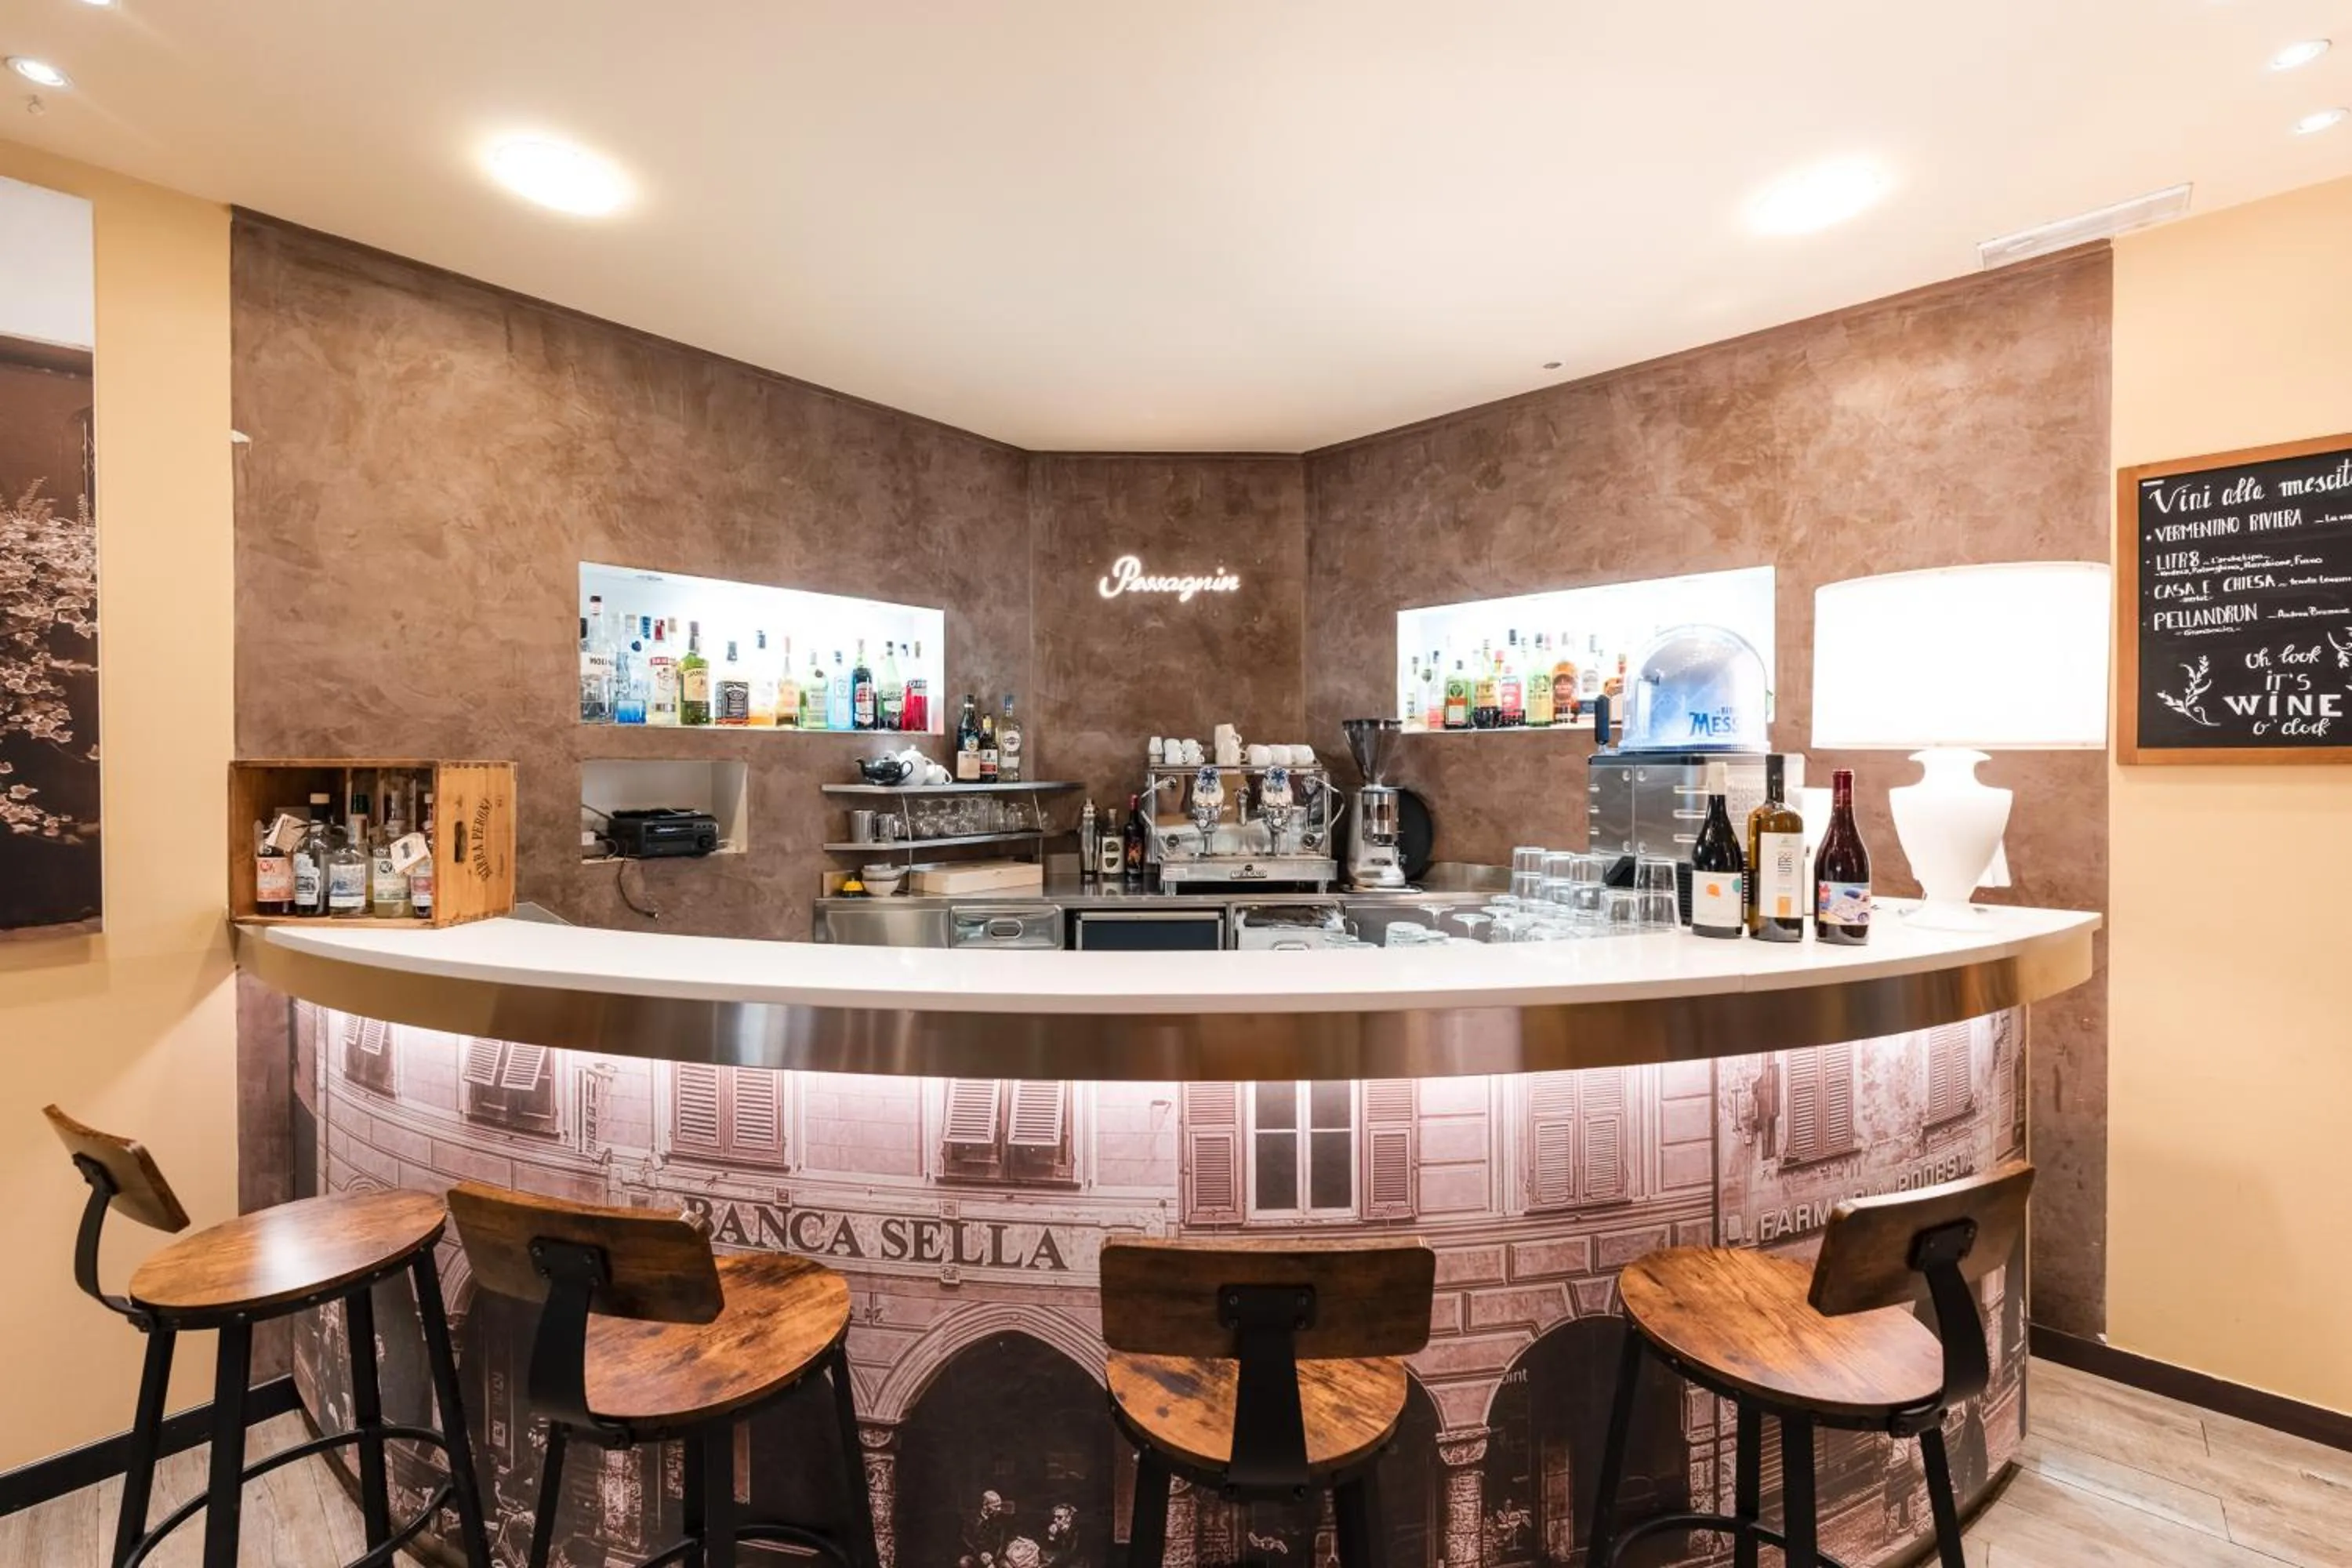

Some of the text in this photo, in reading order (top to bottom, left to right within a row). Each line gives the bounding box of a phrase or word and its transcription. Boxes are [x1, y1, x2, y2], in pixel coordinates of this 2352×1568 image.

[2149, 458, 2352, 514] Vini alla mescit
[2154, 517, 2240, 543] VERMENTINO
[2249, 508, 2303, 532] RIVIERA
[2156, 550, 2200, 571] LITR8
[2154, 582, 2195, 600] CASA
[2202, 580, 2211, 594] E
[2223, 574, 2275, 593] CHIESA
[2154, 602, 2259, 631] PELLANDRUN
[2278, 644, 2322, 664] look
[684, 1196, 1069, 1270] BANCA SELLA
